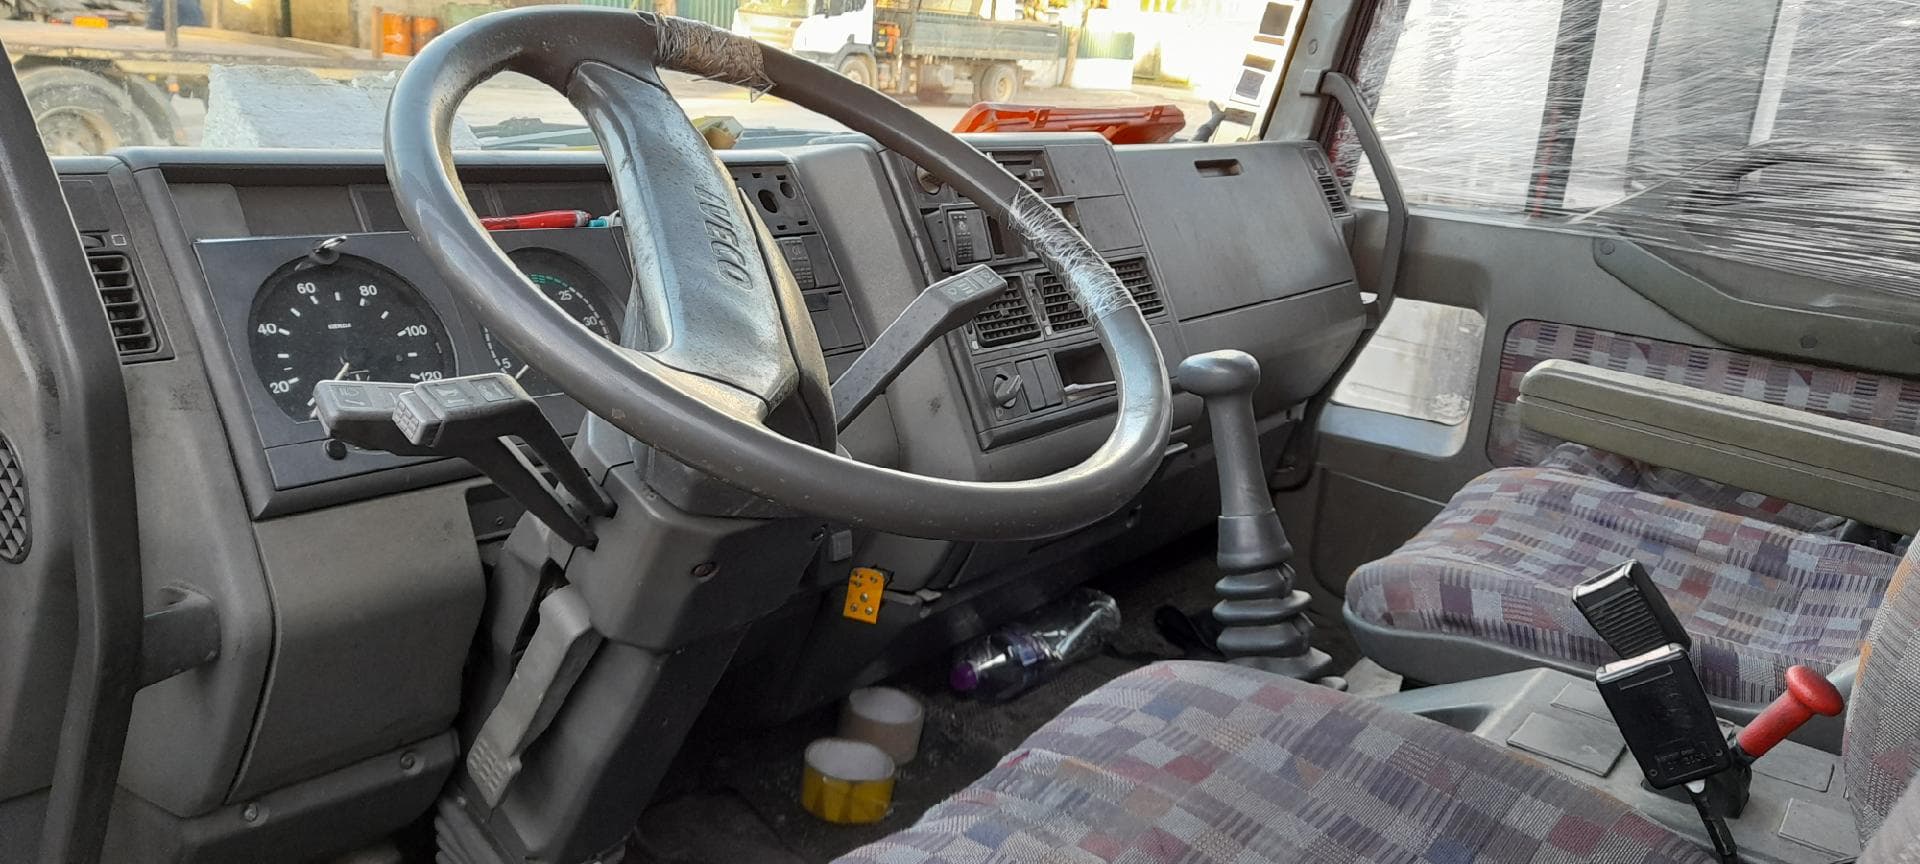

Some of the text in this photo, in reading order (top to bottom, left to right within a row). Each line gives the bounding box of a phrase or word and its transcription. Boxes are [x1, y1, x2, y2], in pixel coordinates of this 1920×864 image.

[694, 185, 753, 290] IVECO
[296, 282, 316, 295] 60
[359, 284, 378, 297] 80
[558, 289, 573, 301] 25
[582, 315, 598, 327] 30
[257, 322, 278, 335] 40
[405, 324, 428, 337] 100
[419, 370, 442, 382] 120
[269, 380, 290, 394] 20
